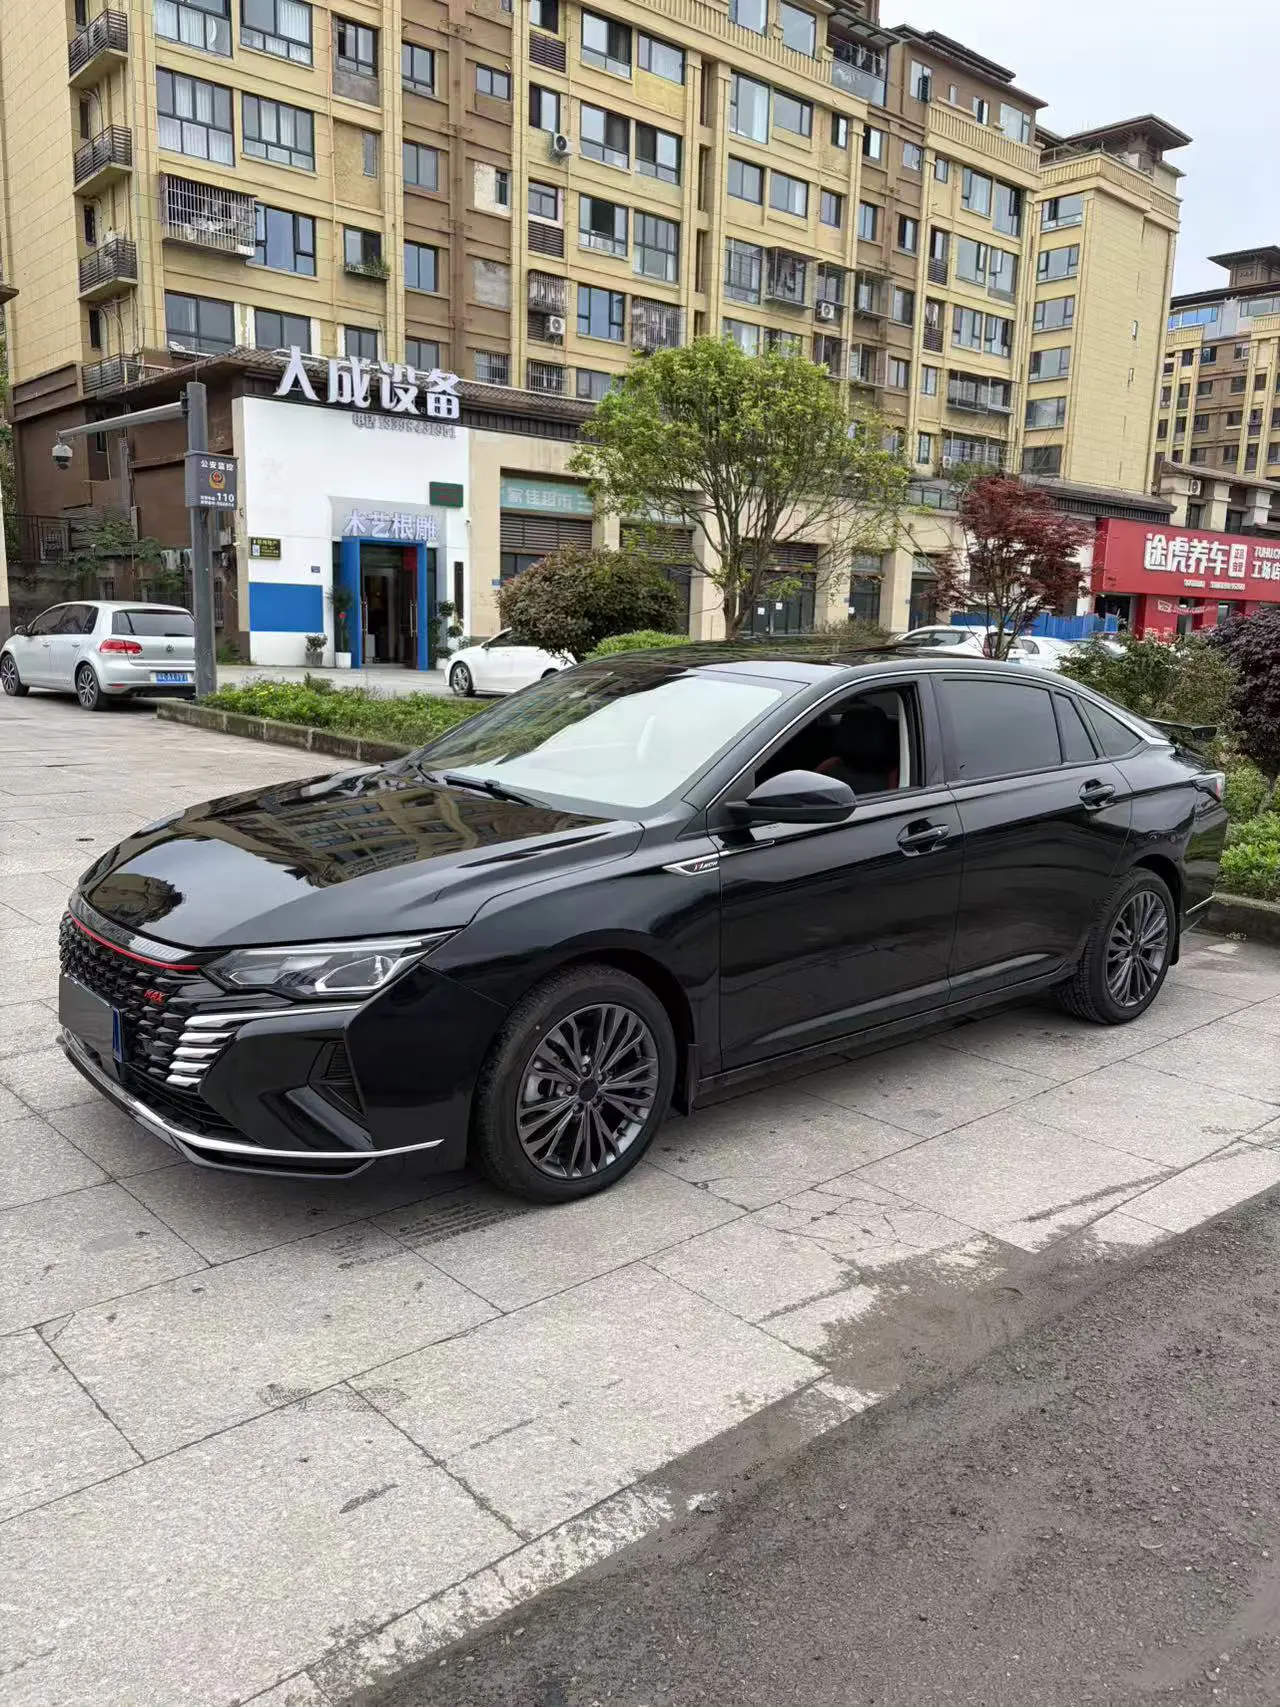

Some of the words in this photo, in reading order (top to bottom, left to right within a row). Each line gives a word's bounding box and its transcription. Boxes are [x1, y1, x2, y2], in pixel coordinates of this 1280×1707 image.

[200, 460, 234, 471] 公安监控
[216, 492, 235, 503] 110
[344, 508, 438, 540] 木艺根雕
[1144, 533, 1230, 576] 途虎养车
[1253, 546, 1280, 560] TUHU.C
